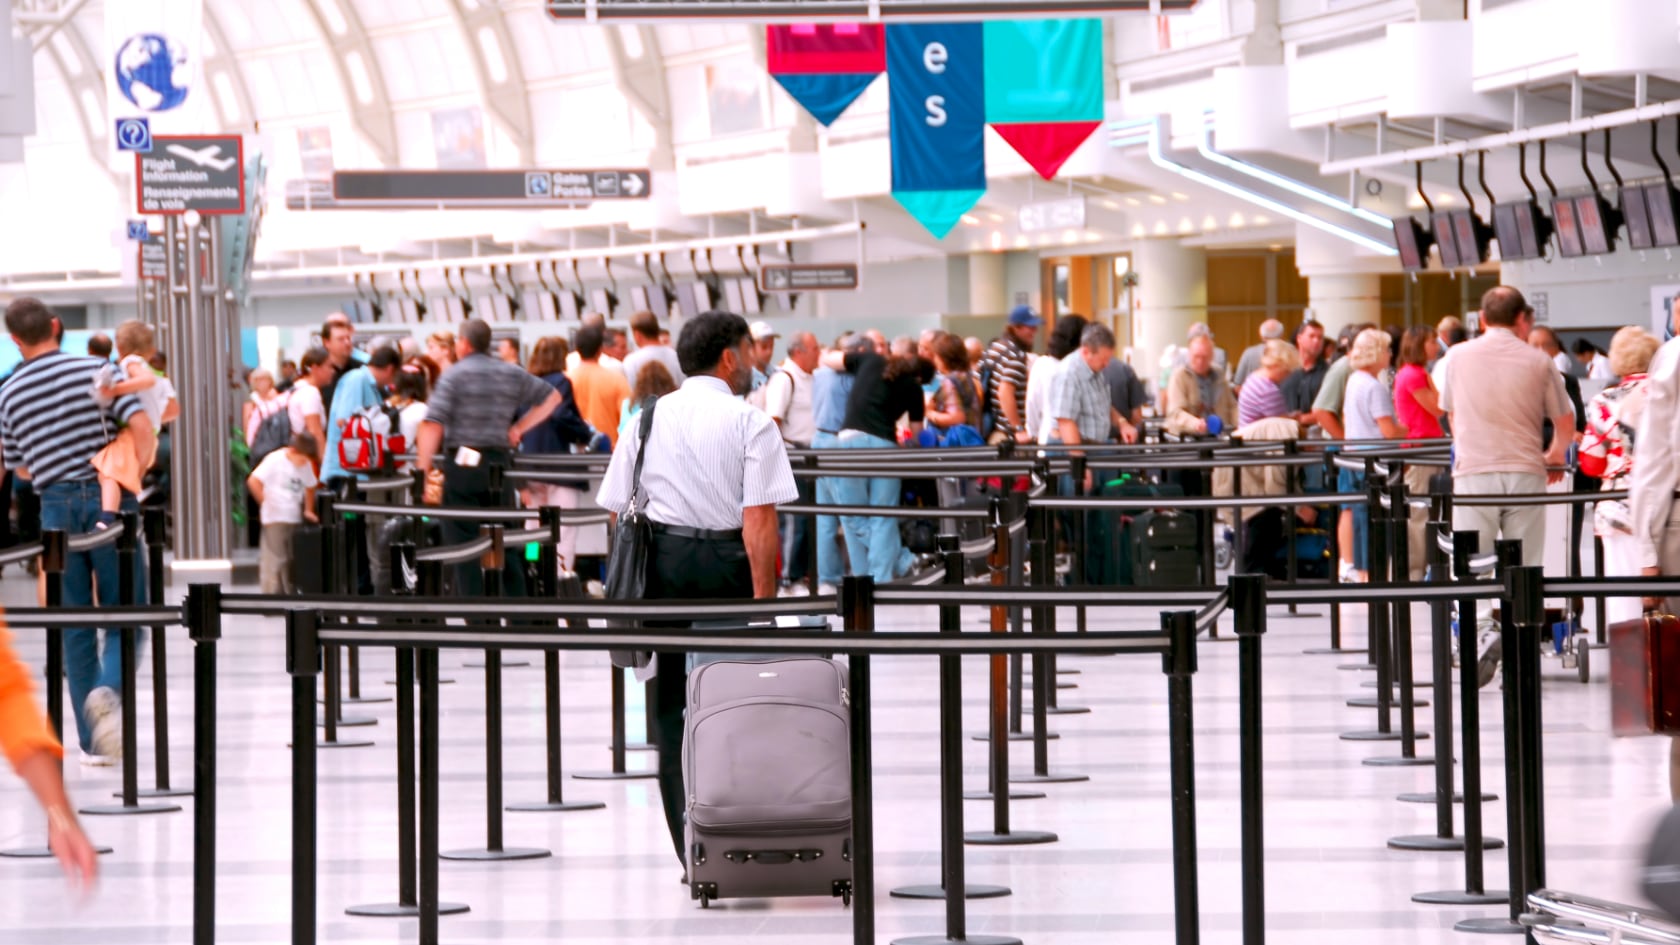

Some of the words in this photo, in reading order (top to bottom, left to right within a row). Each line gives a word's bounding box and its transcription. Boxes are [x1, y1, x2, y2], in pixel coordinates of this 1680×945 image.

[143, 158, 175, 172] Flight
[143, 171, 207, 182] Information
[143, 186, 238, 200] Renseignements
[143, 199, 160, 209] de
[161, 199, 185, 209] vols
